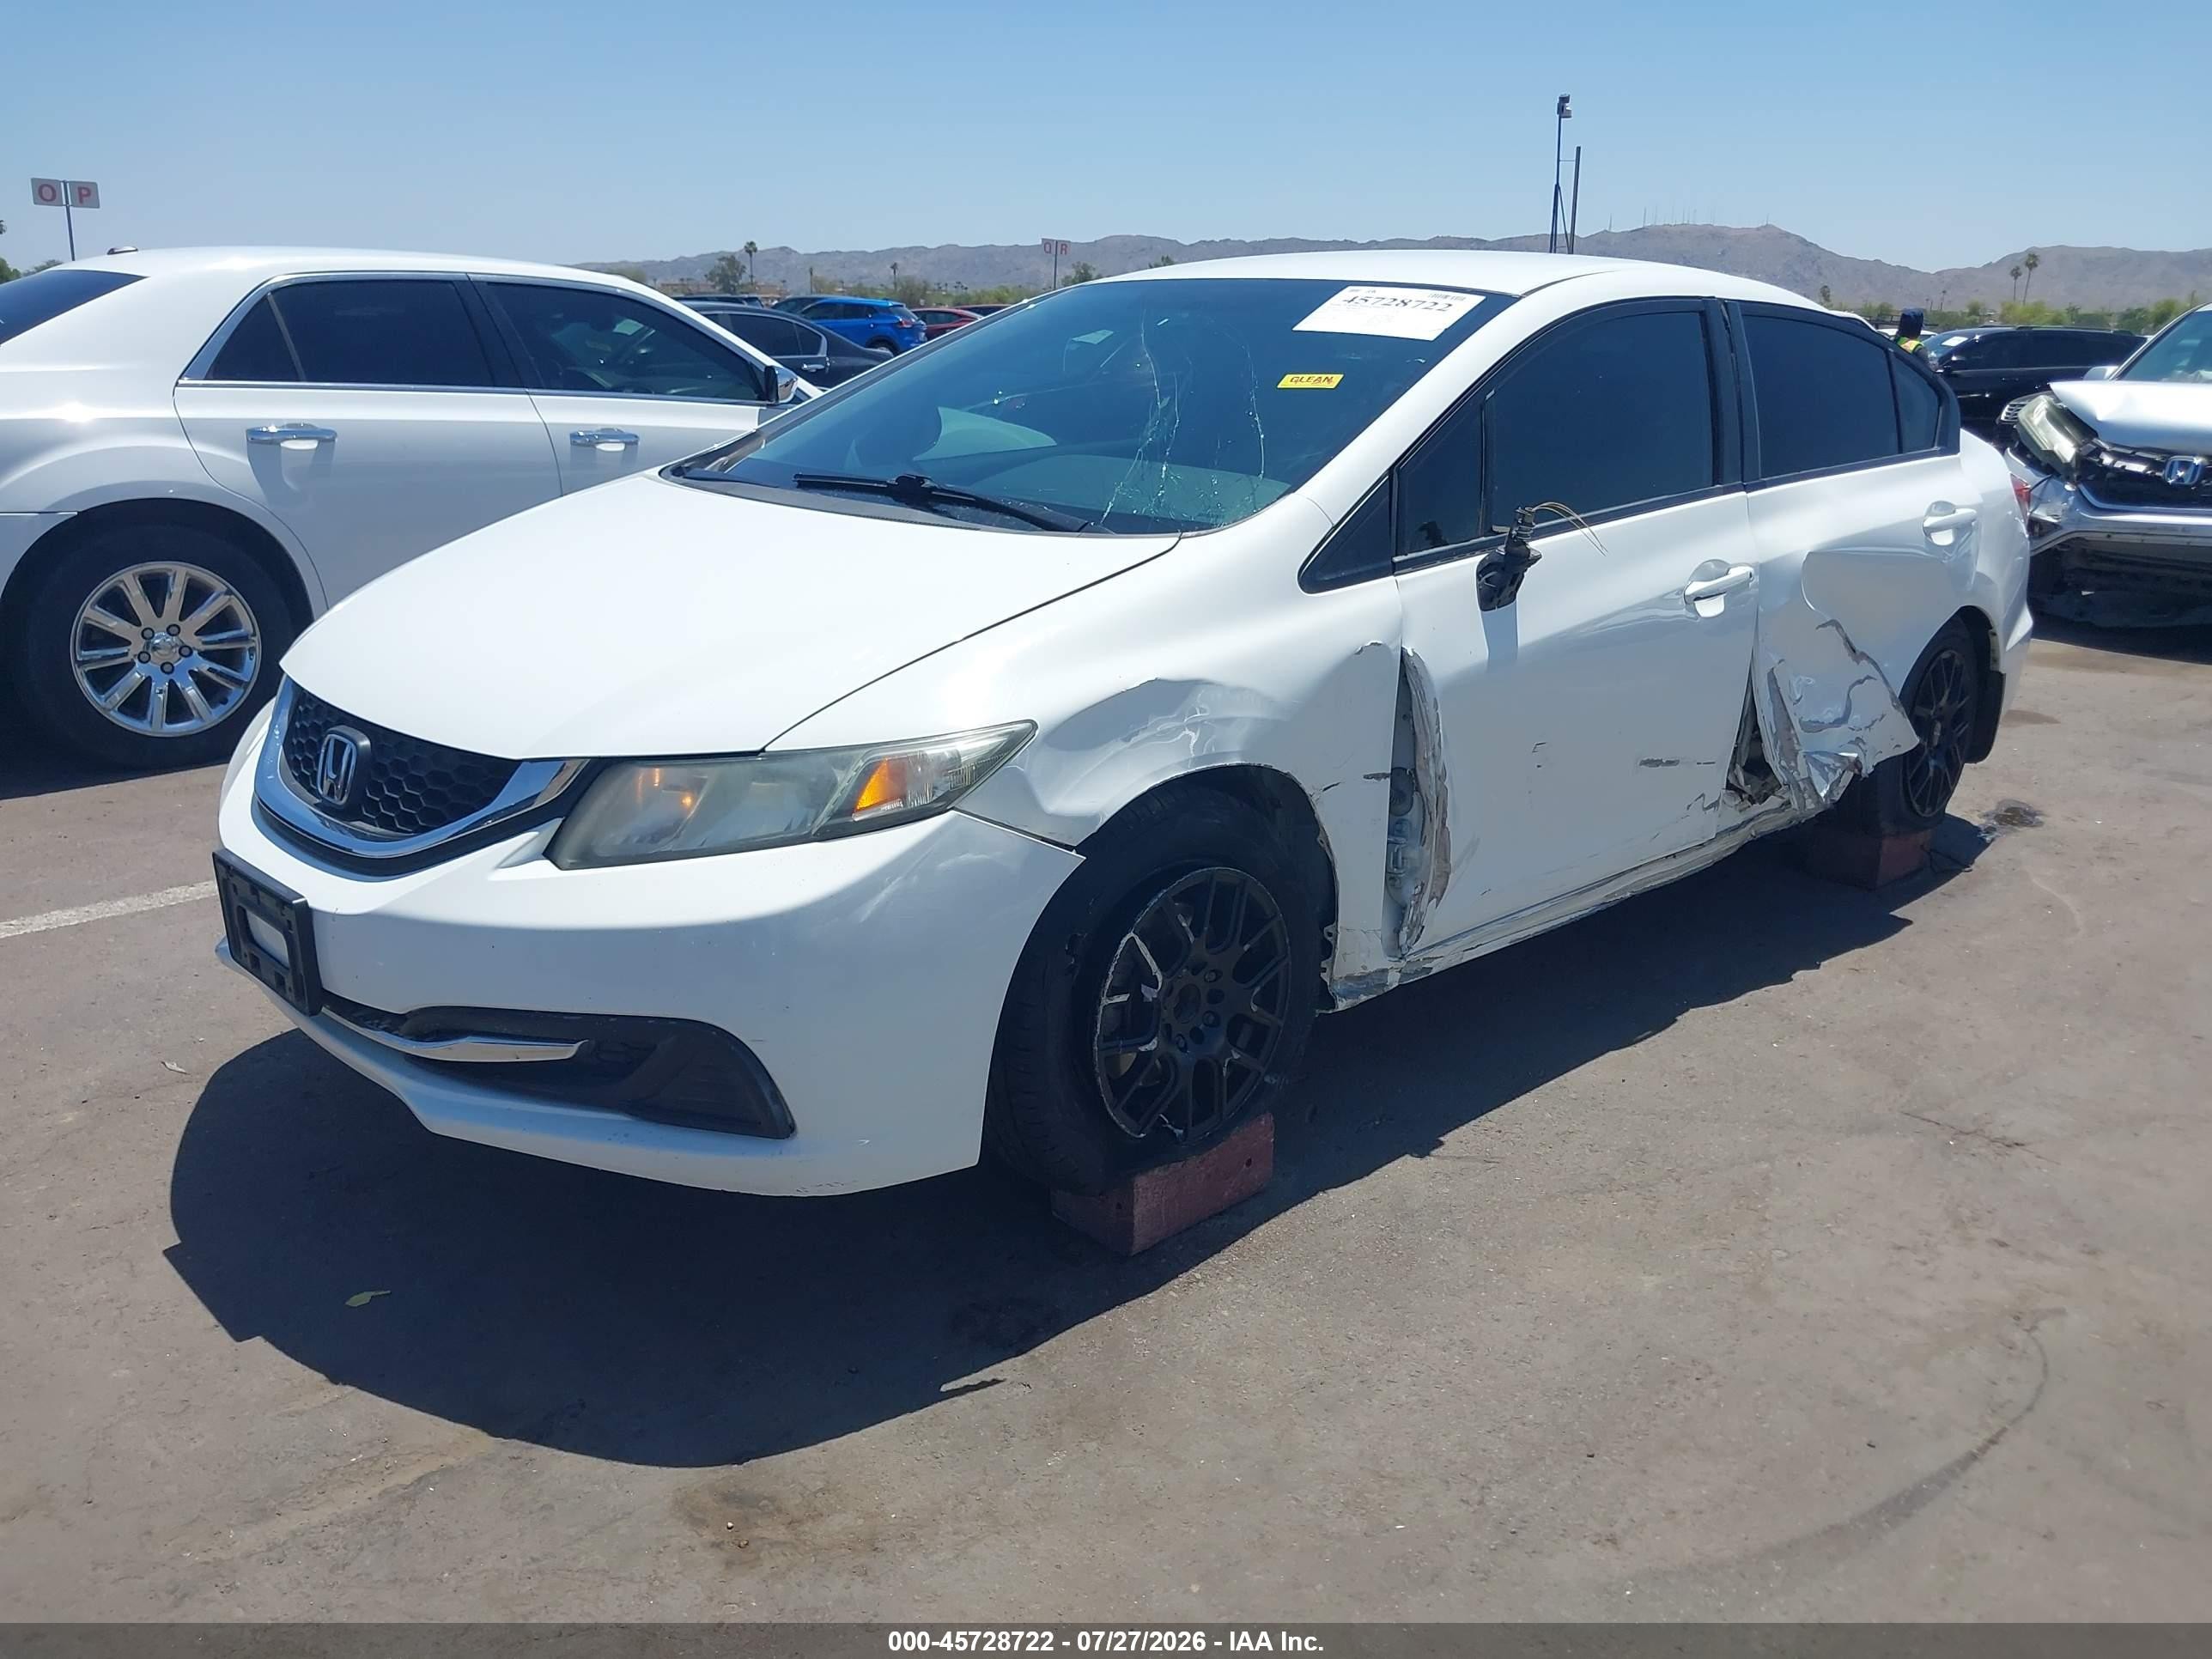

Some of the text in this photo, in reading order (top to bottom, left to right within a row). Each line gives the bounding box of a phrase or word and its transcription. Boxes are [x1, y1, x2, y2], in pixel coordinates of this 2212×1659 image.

[38, 183, 57, 202] O
[77, 185, 91, 204] P
[1342, 295, 1453, 312] 45728722
